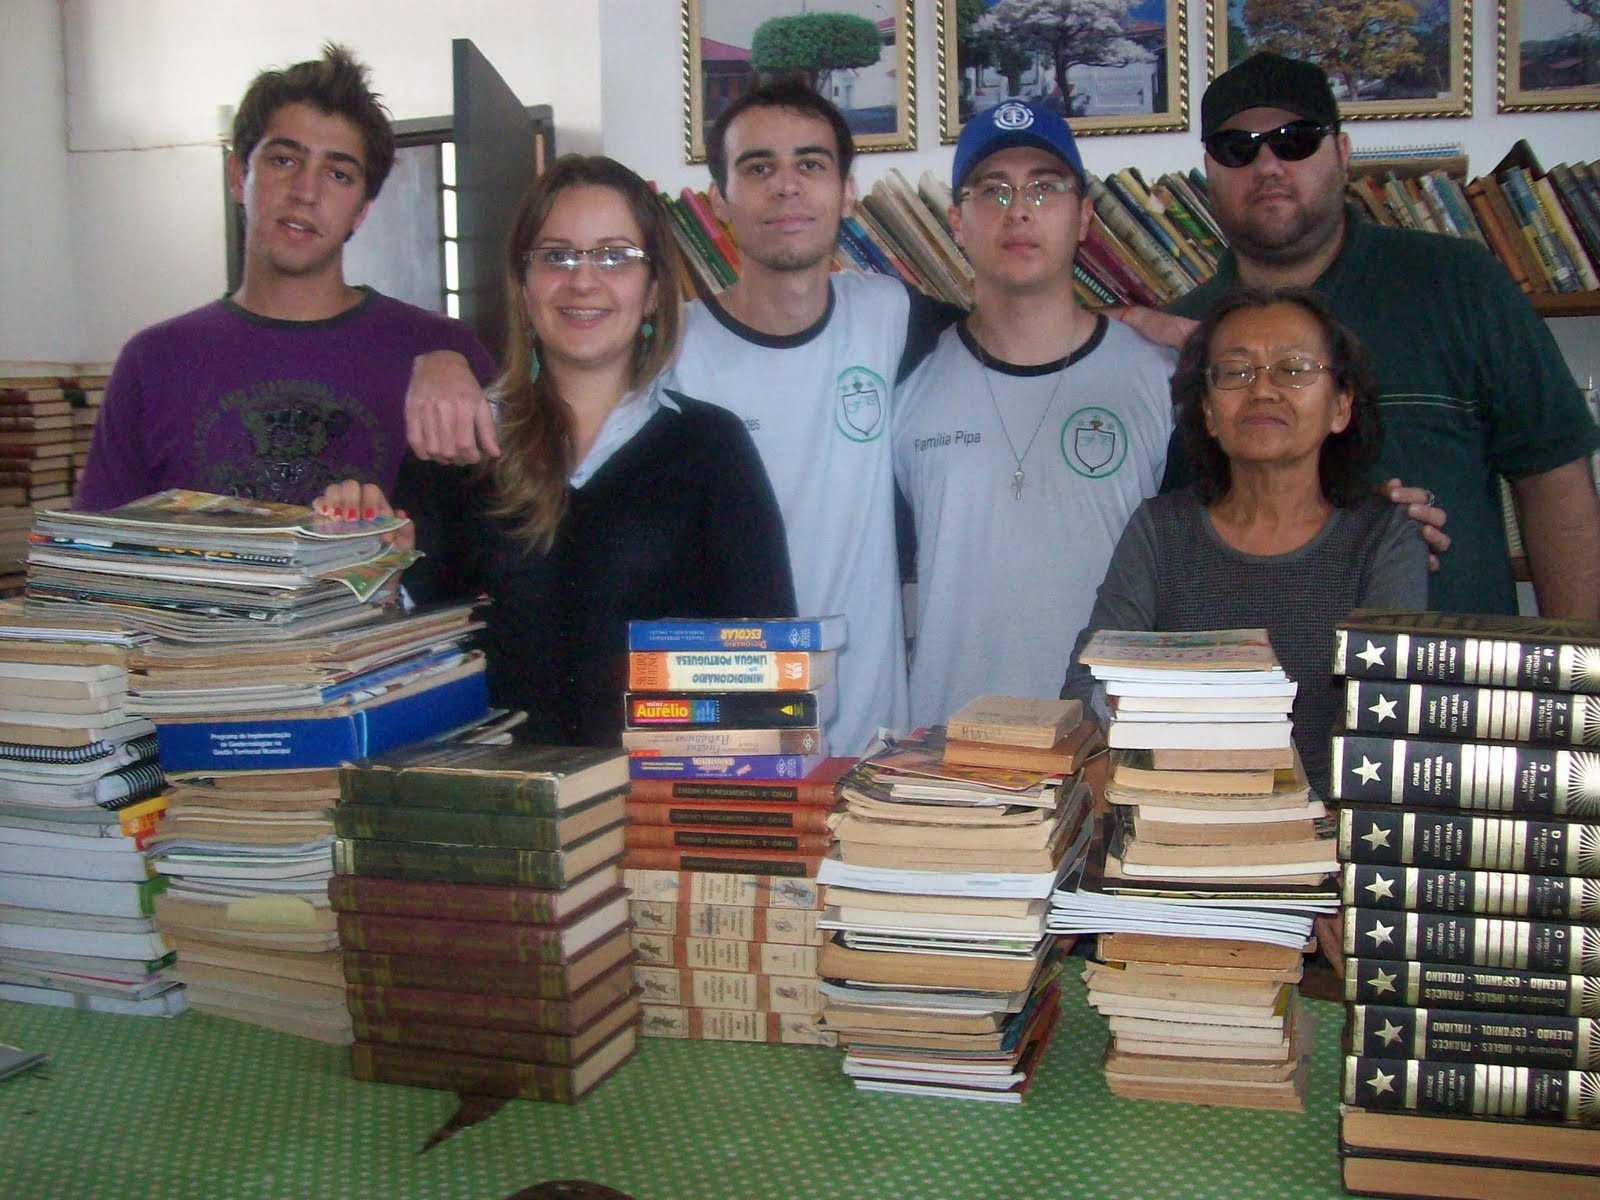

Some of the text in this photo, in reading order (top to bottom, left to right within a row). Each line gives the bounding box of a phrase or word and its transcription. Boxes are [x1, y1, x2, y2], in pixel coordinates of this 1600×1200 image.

[956, 430, 981, 447] Pipa
[720, 628, 762, 640] ESCOLAR
[1439, 640, 1447, 660] BRASIL
[676, 654, 768, 666] LÍNGUA PORTUGUESA
[692, 672, 764, 684] MINIDICIONÁRIO
[636, 703, 688, 718] Aurélio
[1452, 694, 1460, 714] BRASIL
[1557, 702, 1567, 711] Z
[1440, 696, 1448, 728] DICIONÁRIO
[1423, 758, 1432, 791] DICIONÁRIO
[1539, 764, 1551, 772] C
[1551, 830, 1562, 866] D G
[1554, 881, 1564, 889] Z
[1449, 921, 1457, 941] BRASIL
[1555, 930, 1564, 939] O
[1426, 971, 1567, 990] ALEMÃO ESPANHOL ITALIANO
[1425, 988, 1465, 1001] FRANCÊS
[1474, 992, 1506, 1004] INGLÊS
[1432, 1022, 1574, 1041] ALEMÃO ESPANHOL ITALIANO
[1432, 1039, 1472, 1052] FRANCÊS
[1482, 1042, 1512, 1054] INGLÊS
[1552, 1078, 1562, 1086] Z
